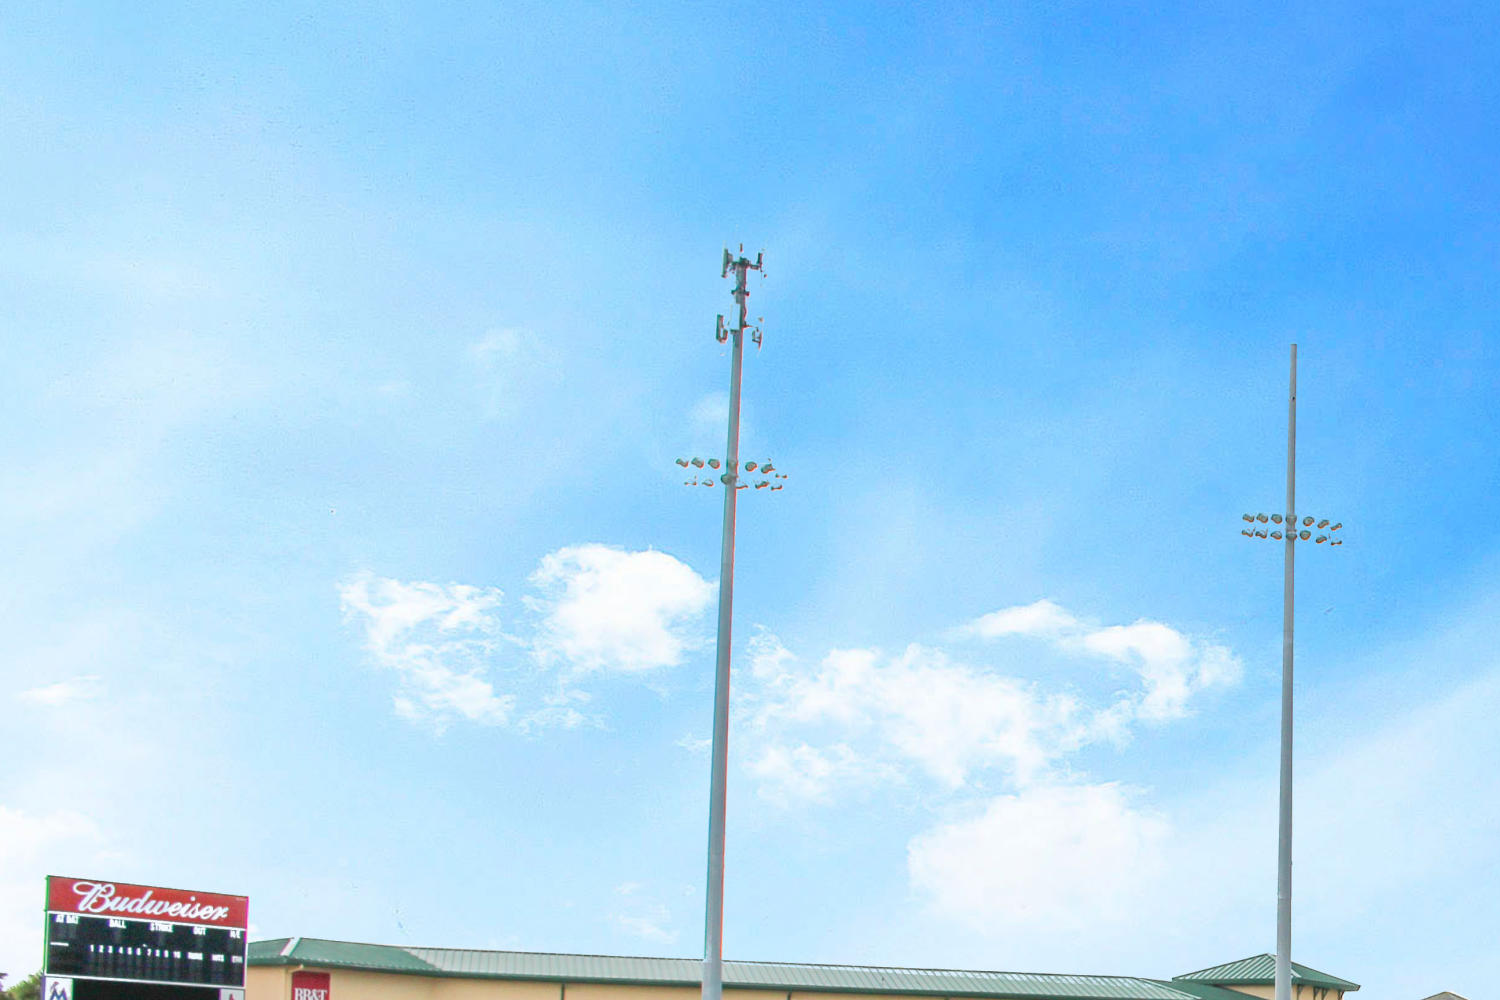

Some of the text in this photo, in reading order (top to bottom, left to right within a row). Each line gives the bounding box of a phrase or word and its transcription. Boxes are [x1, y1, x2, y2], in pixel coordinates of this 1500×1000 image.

[72, 881, 229, 921] Budweiser
[109, 919, 126, 928] BALL
[150, 922, 173, 933] STRIKE
[193, 927, 206, 936] OUT
